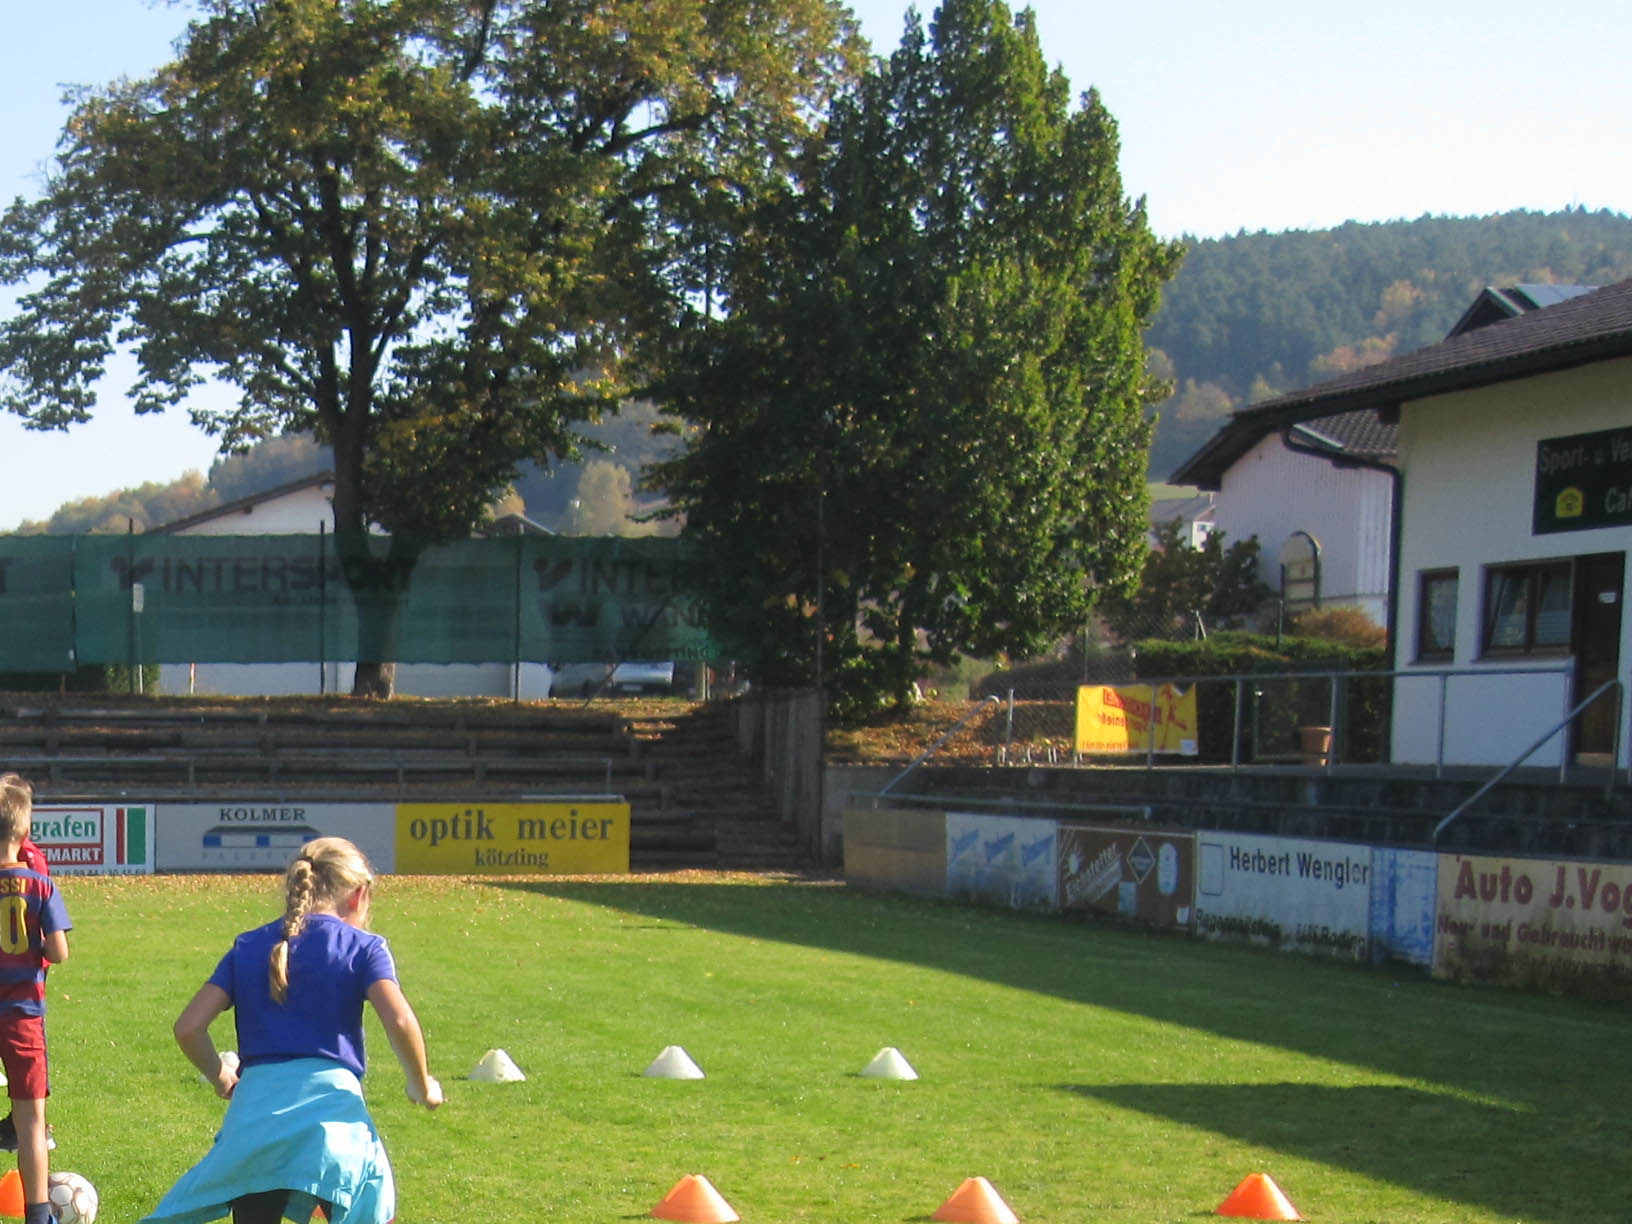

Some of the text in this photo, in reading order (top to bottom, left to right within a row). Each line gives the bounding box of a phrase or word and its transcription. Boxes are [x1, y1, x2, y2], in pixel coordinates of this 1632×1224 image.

[30, 815, 97, 842] grafen
[219, 807, 306, 822] KOLMER
[410, 809, 614, 847] optik meier
[475, 848, 550, 868] kötzting
[1229, 846, 1291, 876] Herbert
[1454, 859, 1534, 905] Auto
